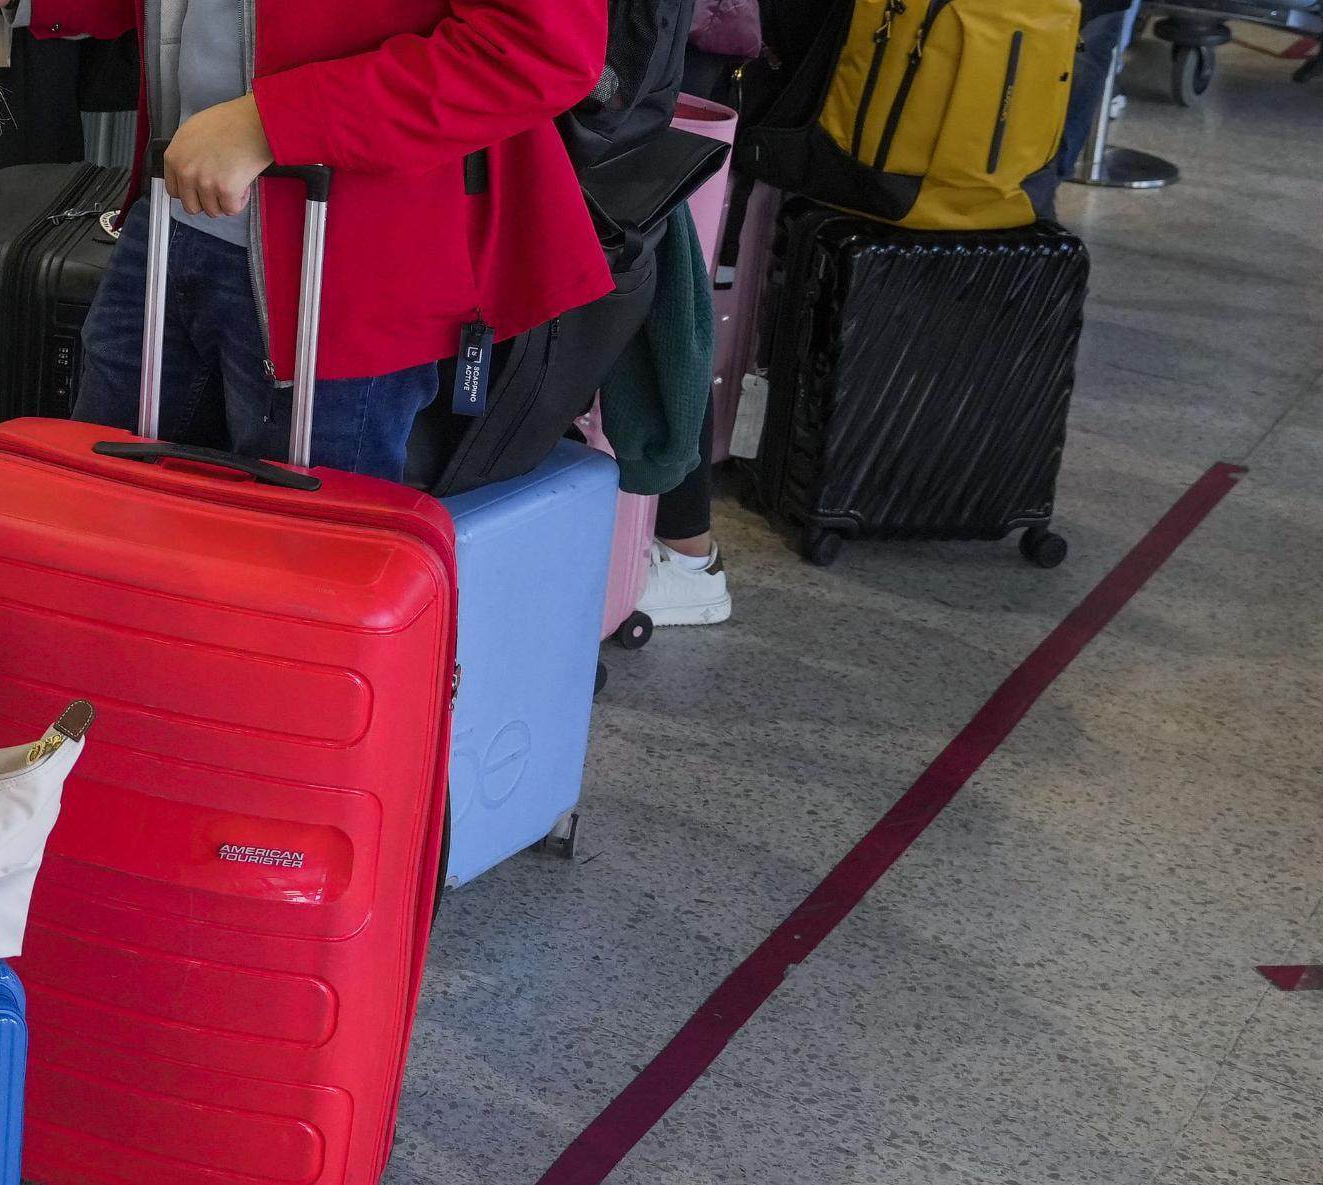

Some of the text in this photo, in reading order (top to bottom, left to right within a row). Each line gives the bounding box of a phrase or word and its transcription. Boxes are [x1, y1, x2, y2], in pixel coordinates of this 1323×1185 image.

[463, 364, 473, 391] ACTIVE
[469, 364, 480, 403] SCAPPINO
[218, 852, 304, 869] TOURISTER
[219, 843, 305, 861] AMERICAN
